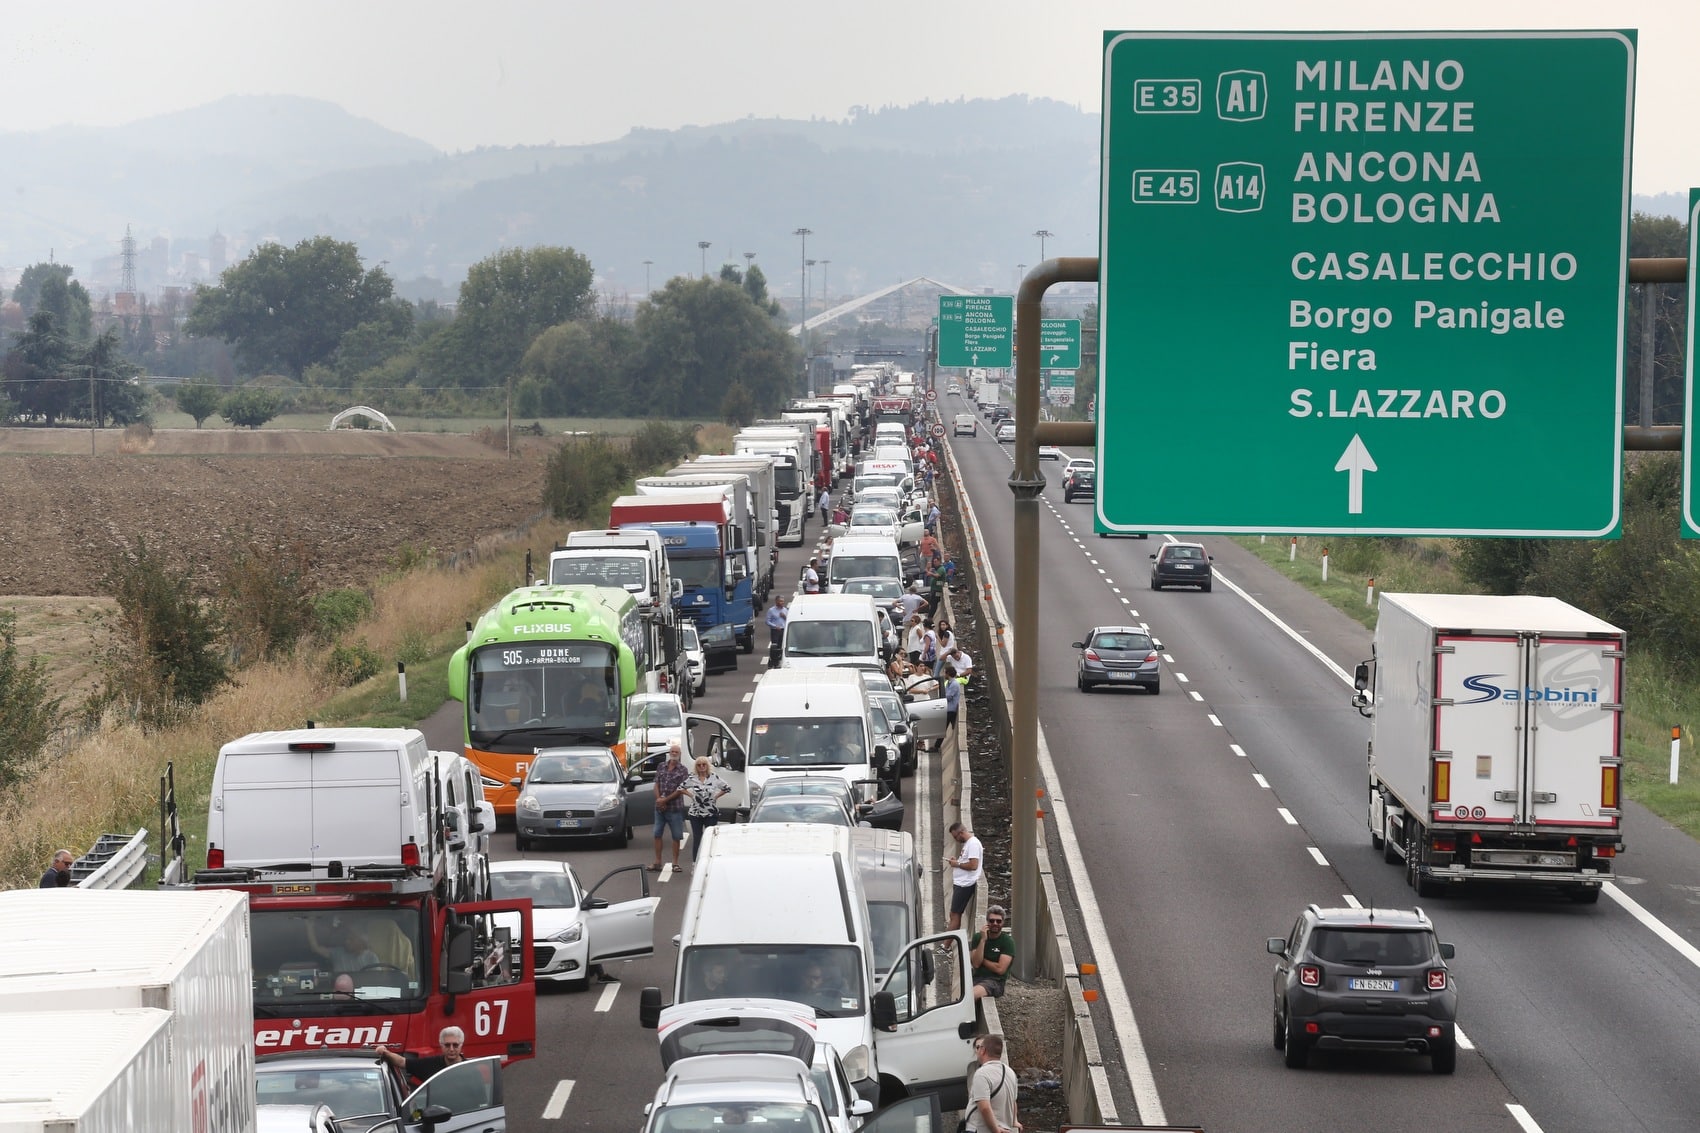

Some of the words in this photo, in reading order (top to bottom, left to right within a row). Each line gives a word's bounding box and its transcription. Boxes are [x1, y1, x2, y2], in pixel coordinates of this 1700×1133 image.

[1295, 60, 1465, 91] MILANO
[1139, 87, 1157, 107] E
[1162, 86, 1197, 107] 35
[1226, 80, 1258, 112] A1
[1294, 101, 1475, 132] FIRENZE
[1293, 151, 1482, 183] ANCONA
[1138, 177, 1154, 197] E
[1158, 176, 1195, 198] 45
[1219, 174, 1261, 200] A14
[1292, 193, 1501, 224] BOLOGNA
[1291, 251, 1578, 281] CASALECCHIO
[1289, 299, 1393, 334] Borgo
[1414, 300, 1565, 335] Panigale
[1289, 341, 1377, 371] Fiera
[1288, 388, 1507, 419] S.LAZZARO
[503, 650, 523, 665] 505
[540, 648, 570, 657] UDINE
[1455, 674, 1598, 704] Sabbini
[277, 885, 312, 893] ROLFO
[1354, 979, 1365, 990] FN
[475, 1000, 509, 1037] 67
[255, 1021, 393, 1047] ertani
